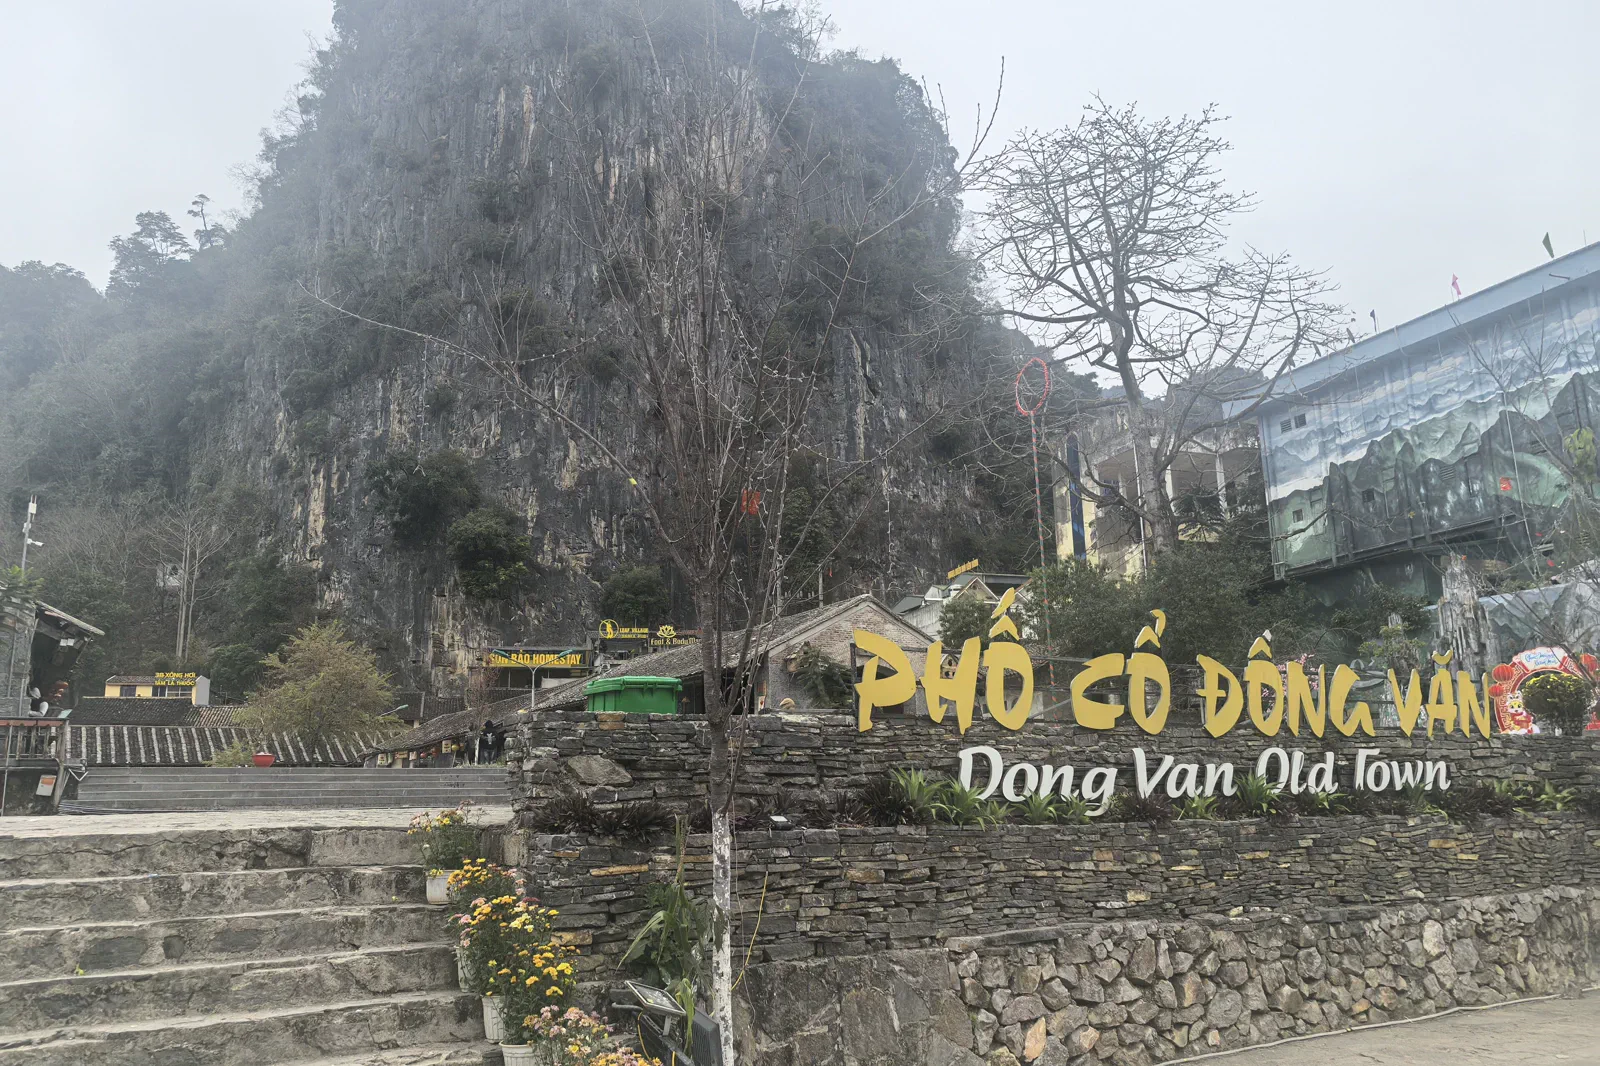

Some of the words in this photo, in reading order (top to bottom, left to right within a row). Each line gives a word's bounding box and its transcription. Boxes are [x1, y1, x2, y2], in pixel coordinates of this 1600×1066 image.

[532, 653, 582, 665] HOMESTAY
[853, 587, 1034, 735] PHỐ
[1070, 609, 1171, 735] CỔ
[1196, 629, 1375, 738] ĐỒNG
[1387, 650, 1491, 739] VĂN
[957, 745, 1118, 817] Dong
[1132, 747, 1239, 798] Van
[1255, 747, 1339, 795] Old
[1354, 748, 1451, 793] Town
